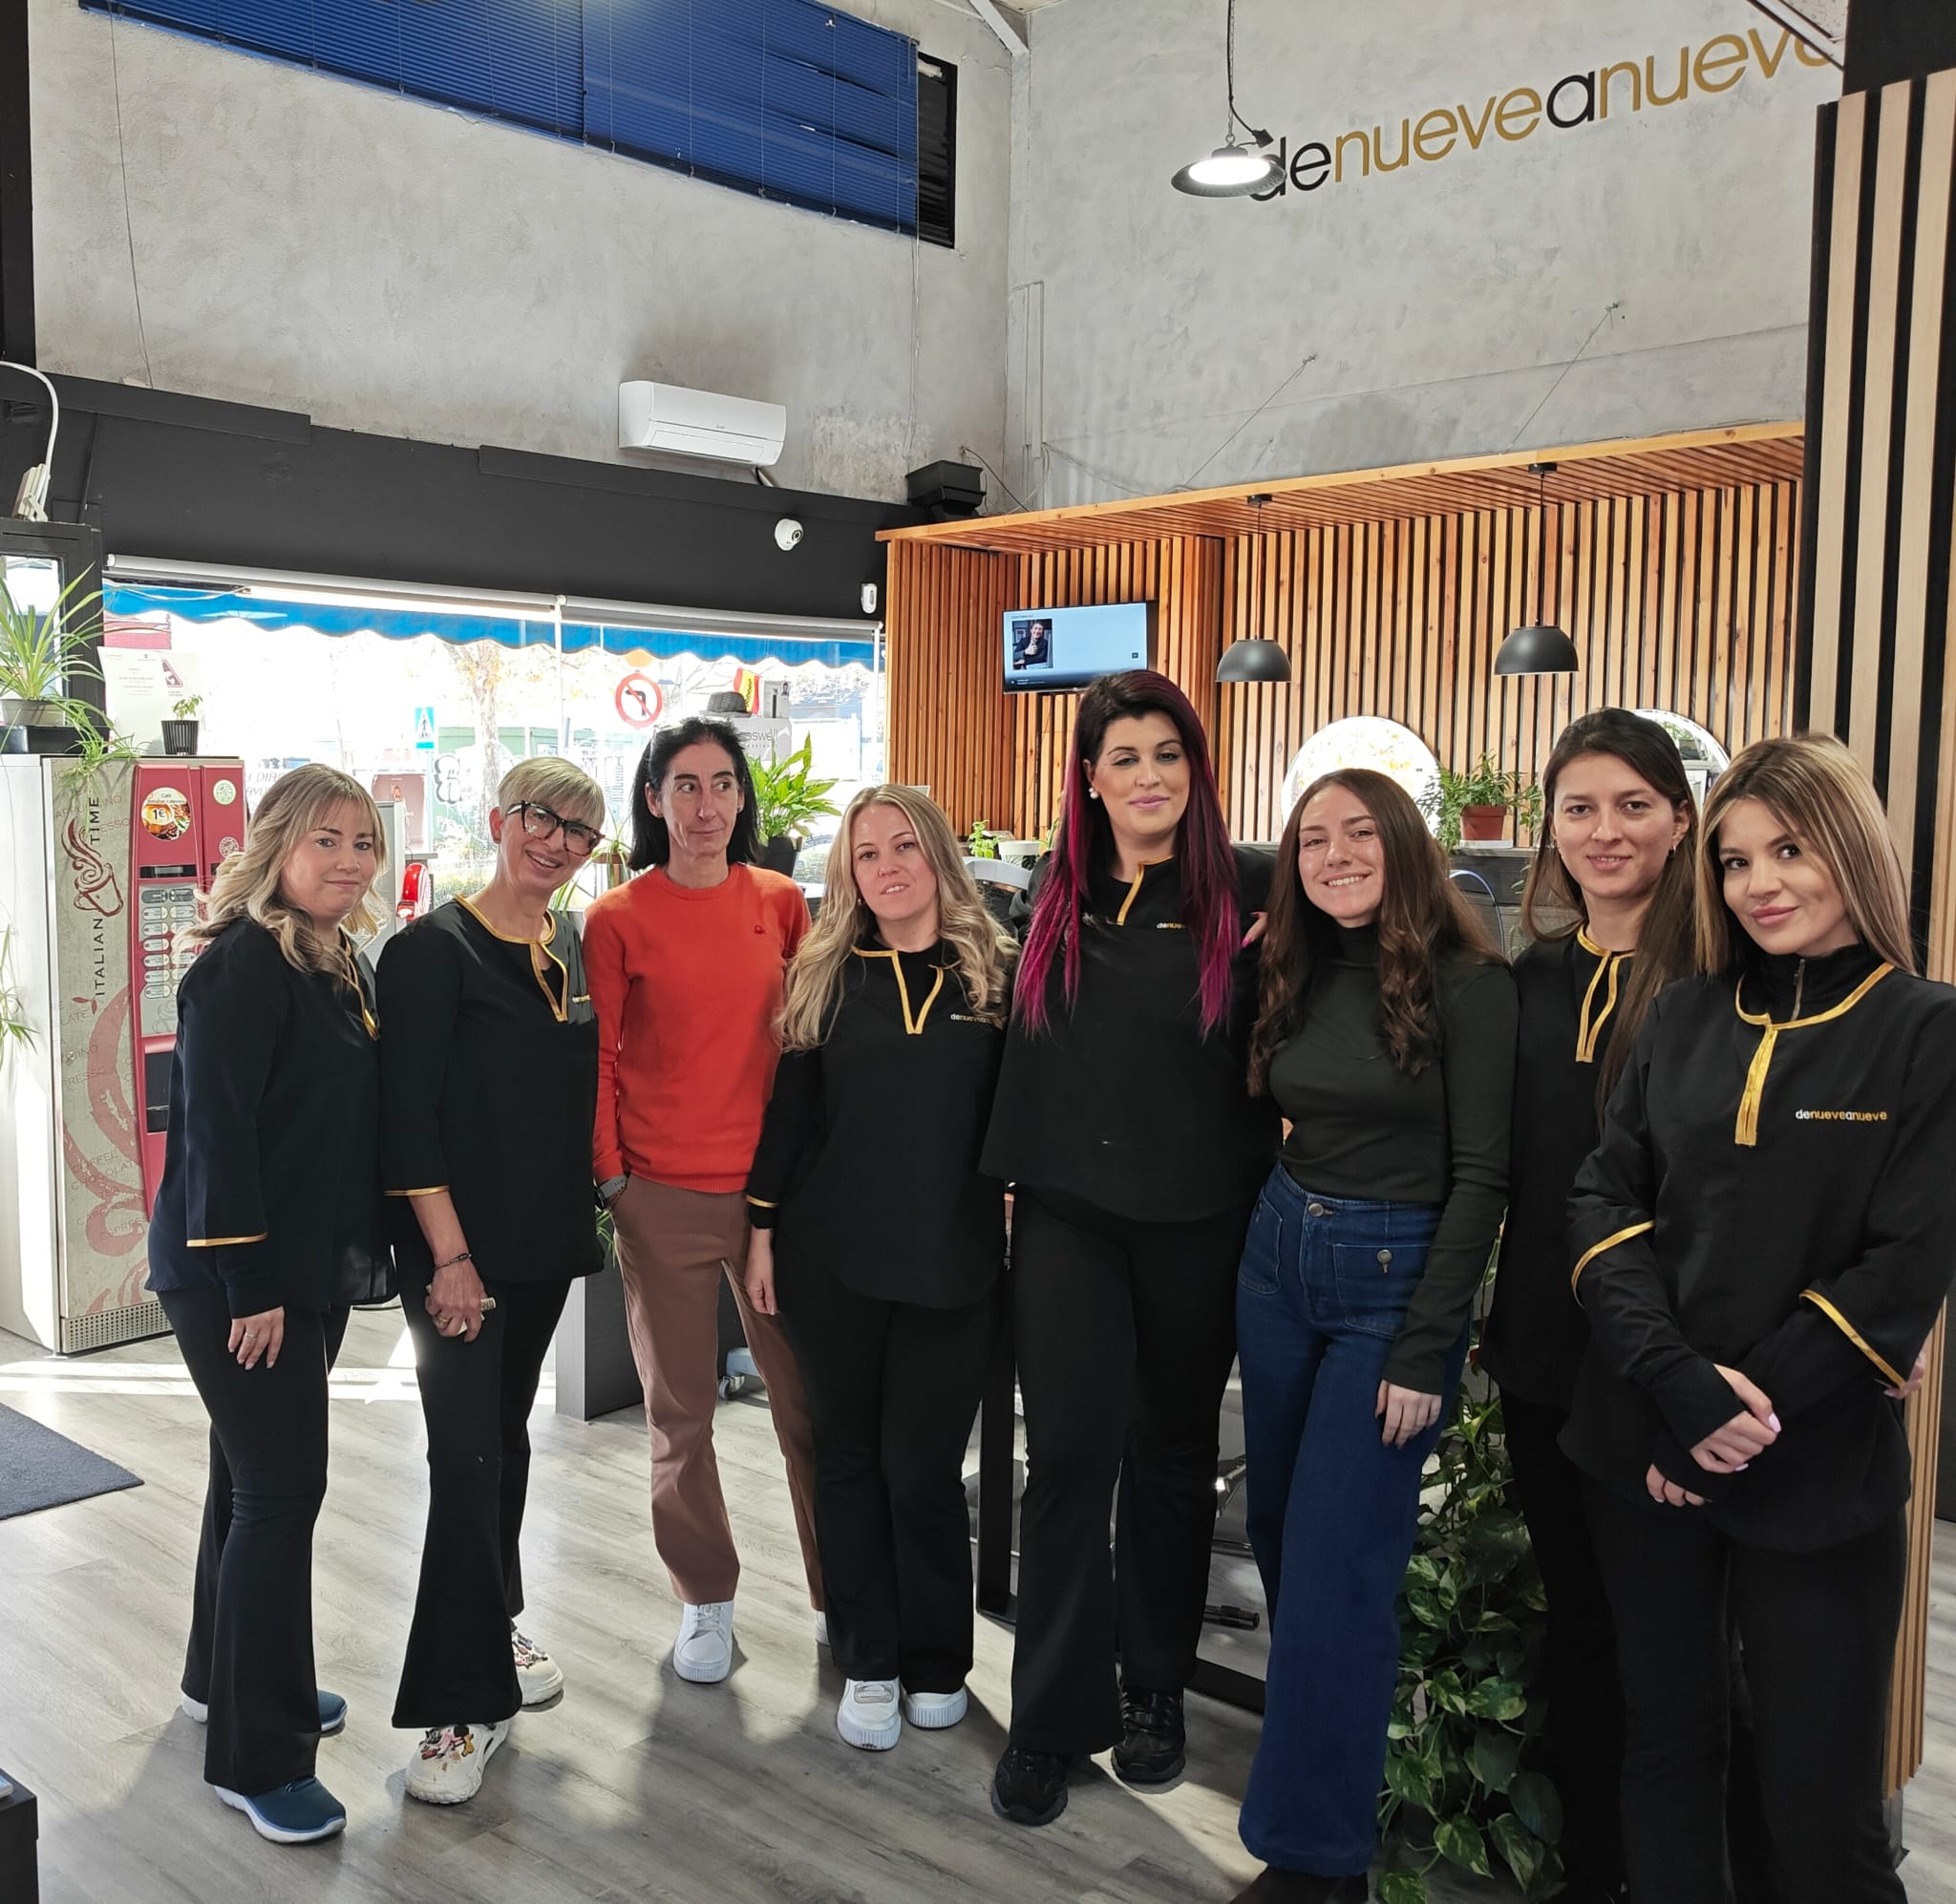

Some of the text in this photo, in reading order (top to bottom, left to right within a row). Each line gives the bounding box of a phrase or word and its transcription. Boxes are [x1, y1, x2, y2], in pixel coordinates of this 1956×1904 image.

[153, 808, 165, 820] 1€
[88, 796, 105, 996] ITALIAN TIME
[1796, 1109, 1887, 1122] denueveanueve
